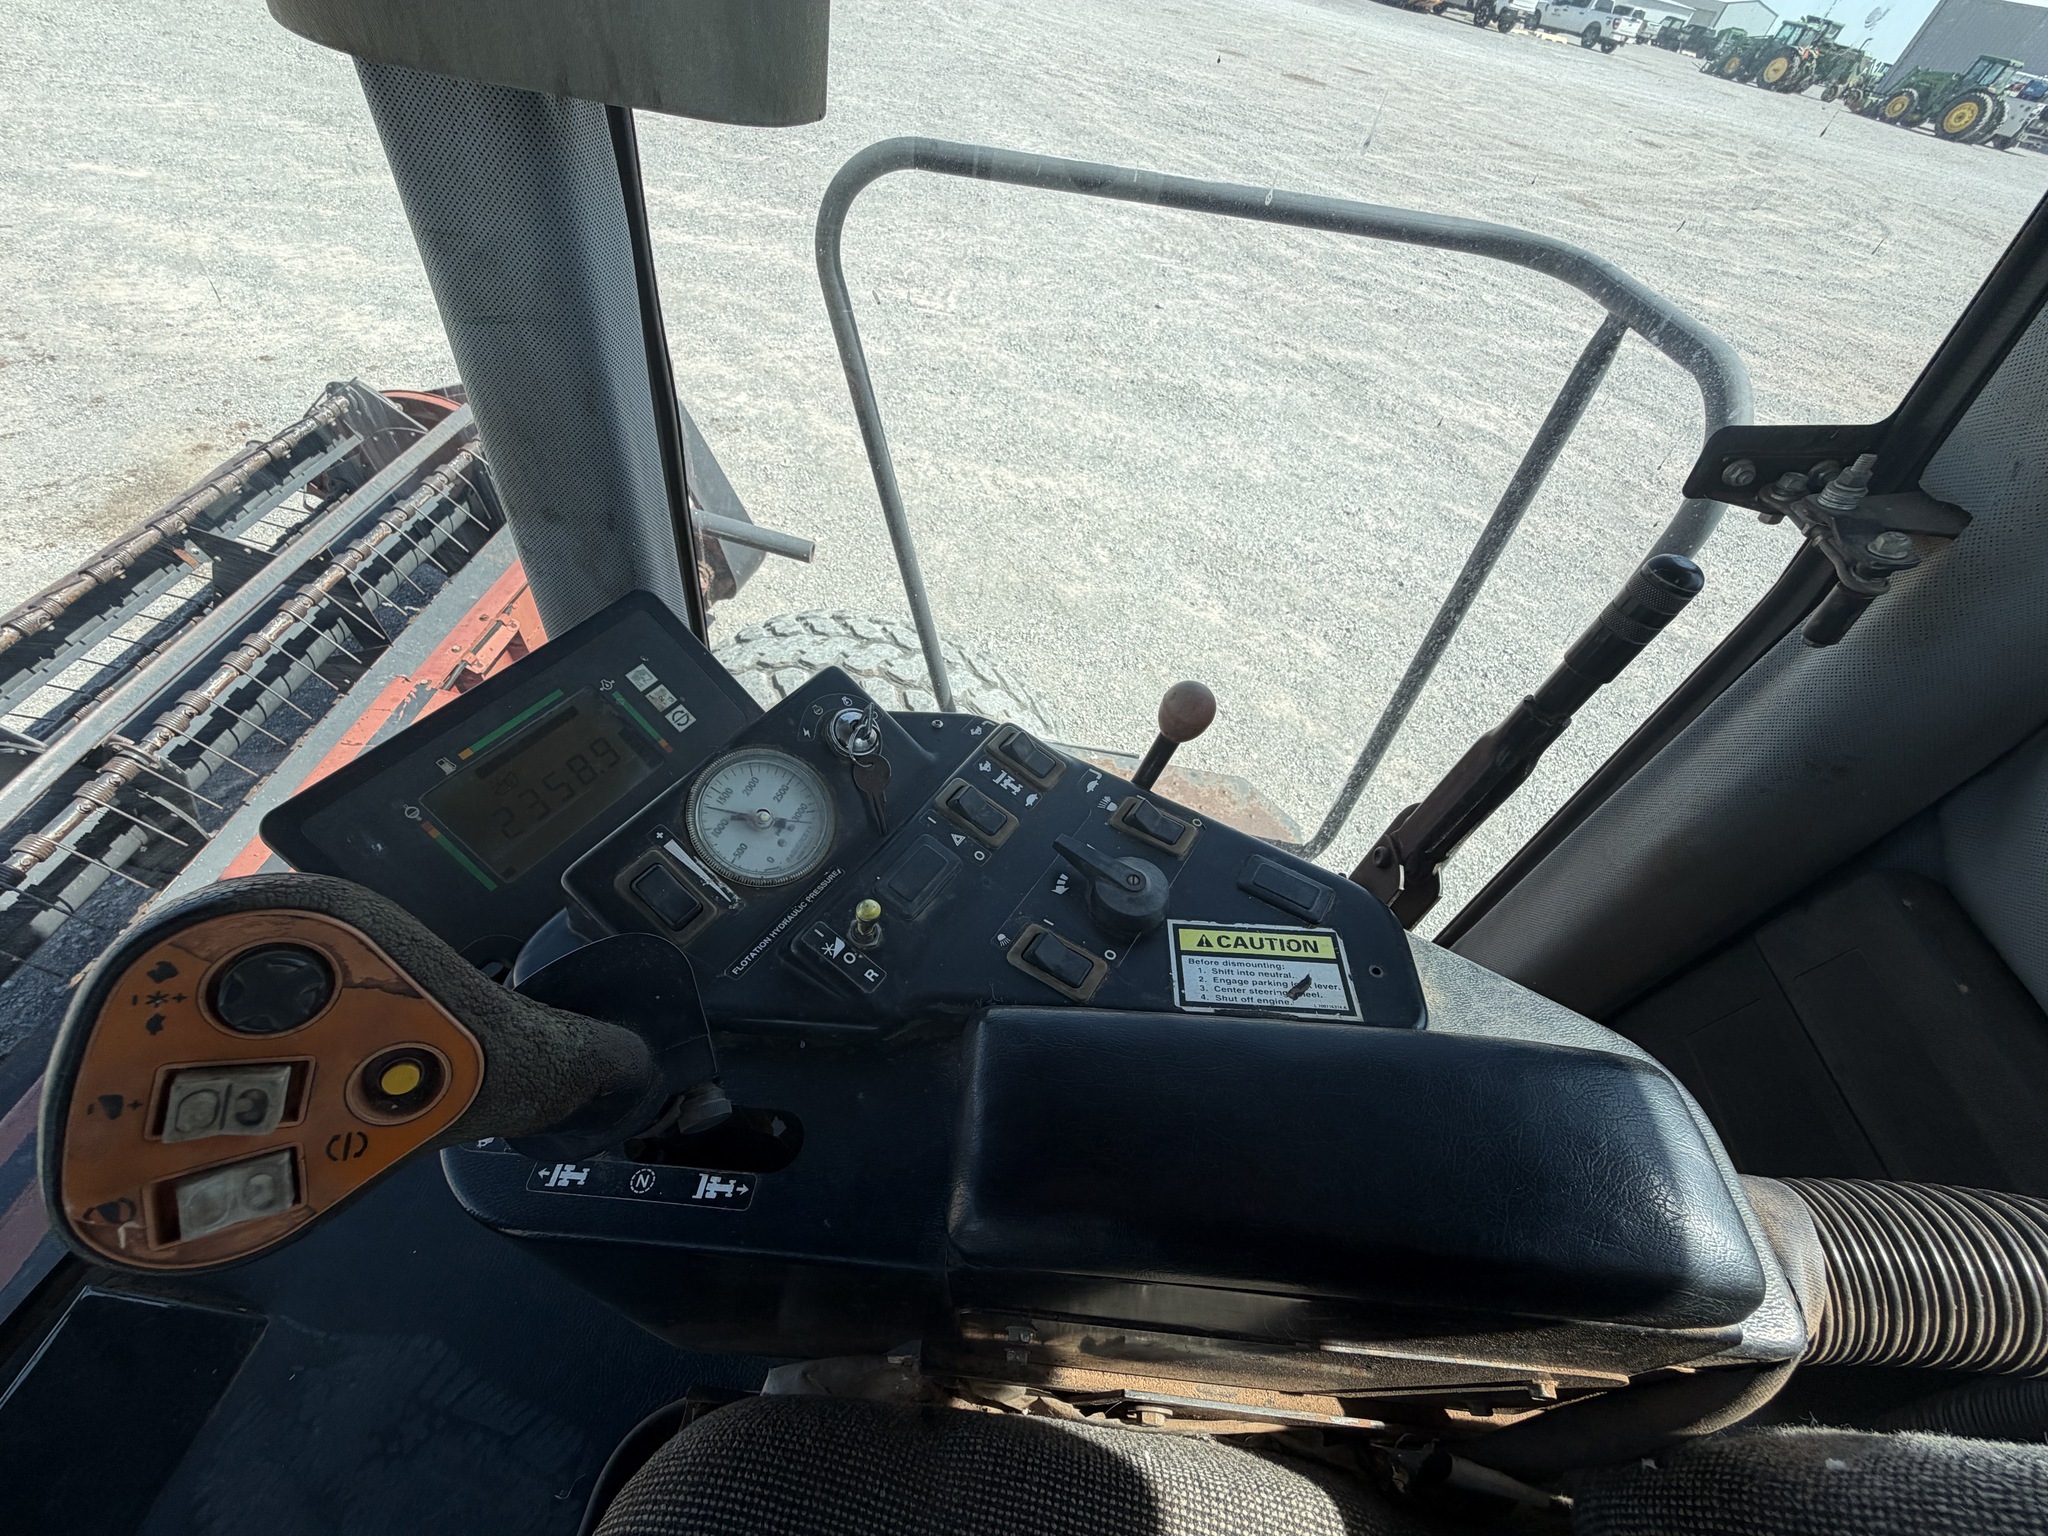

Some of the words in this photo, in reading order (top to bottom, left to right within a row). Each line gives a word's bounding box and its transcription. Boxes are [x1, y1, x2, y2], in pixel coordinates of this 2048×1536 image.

[741, 776, 760, 797] 2000
[772, 784, 790, 803] 2500
[715, 787, 734, 805] 1500
[792, 803, 808, 821] 3000
[710, 818, 729, 838] 1000
[733, 842, 748, 860] 500
[766, 856, 775, 864] 0
[731, 936, 772, 975] FLOTATION
[769, 901, 808, 939] HYDRAULIC
[805, 869, 839, 903] PRESSURE
[1217, 935, 1320, 953] CAUTION
[1188, 958, 1219, 966] Before
[1222, 960, 1285, 971] dismounting:
[863, 969, 880, 982] R
[1211, 967, 1234, 975] Shift
[1258, 971, 1295, 979] neutral.
[1213, 976, 1249, 986] Engage
[1252, 979, 1288, 989] parking
[1314, 982, 1341, 990] lever.
[1214, 985, 1246, 993] Center
[1249, 987, 1288, 997] steering
[1215, 994, 1238, 1002] Shut
[1257, 998, 1293, 1006] engine.
[635, 1173, 650, 1188] N
